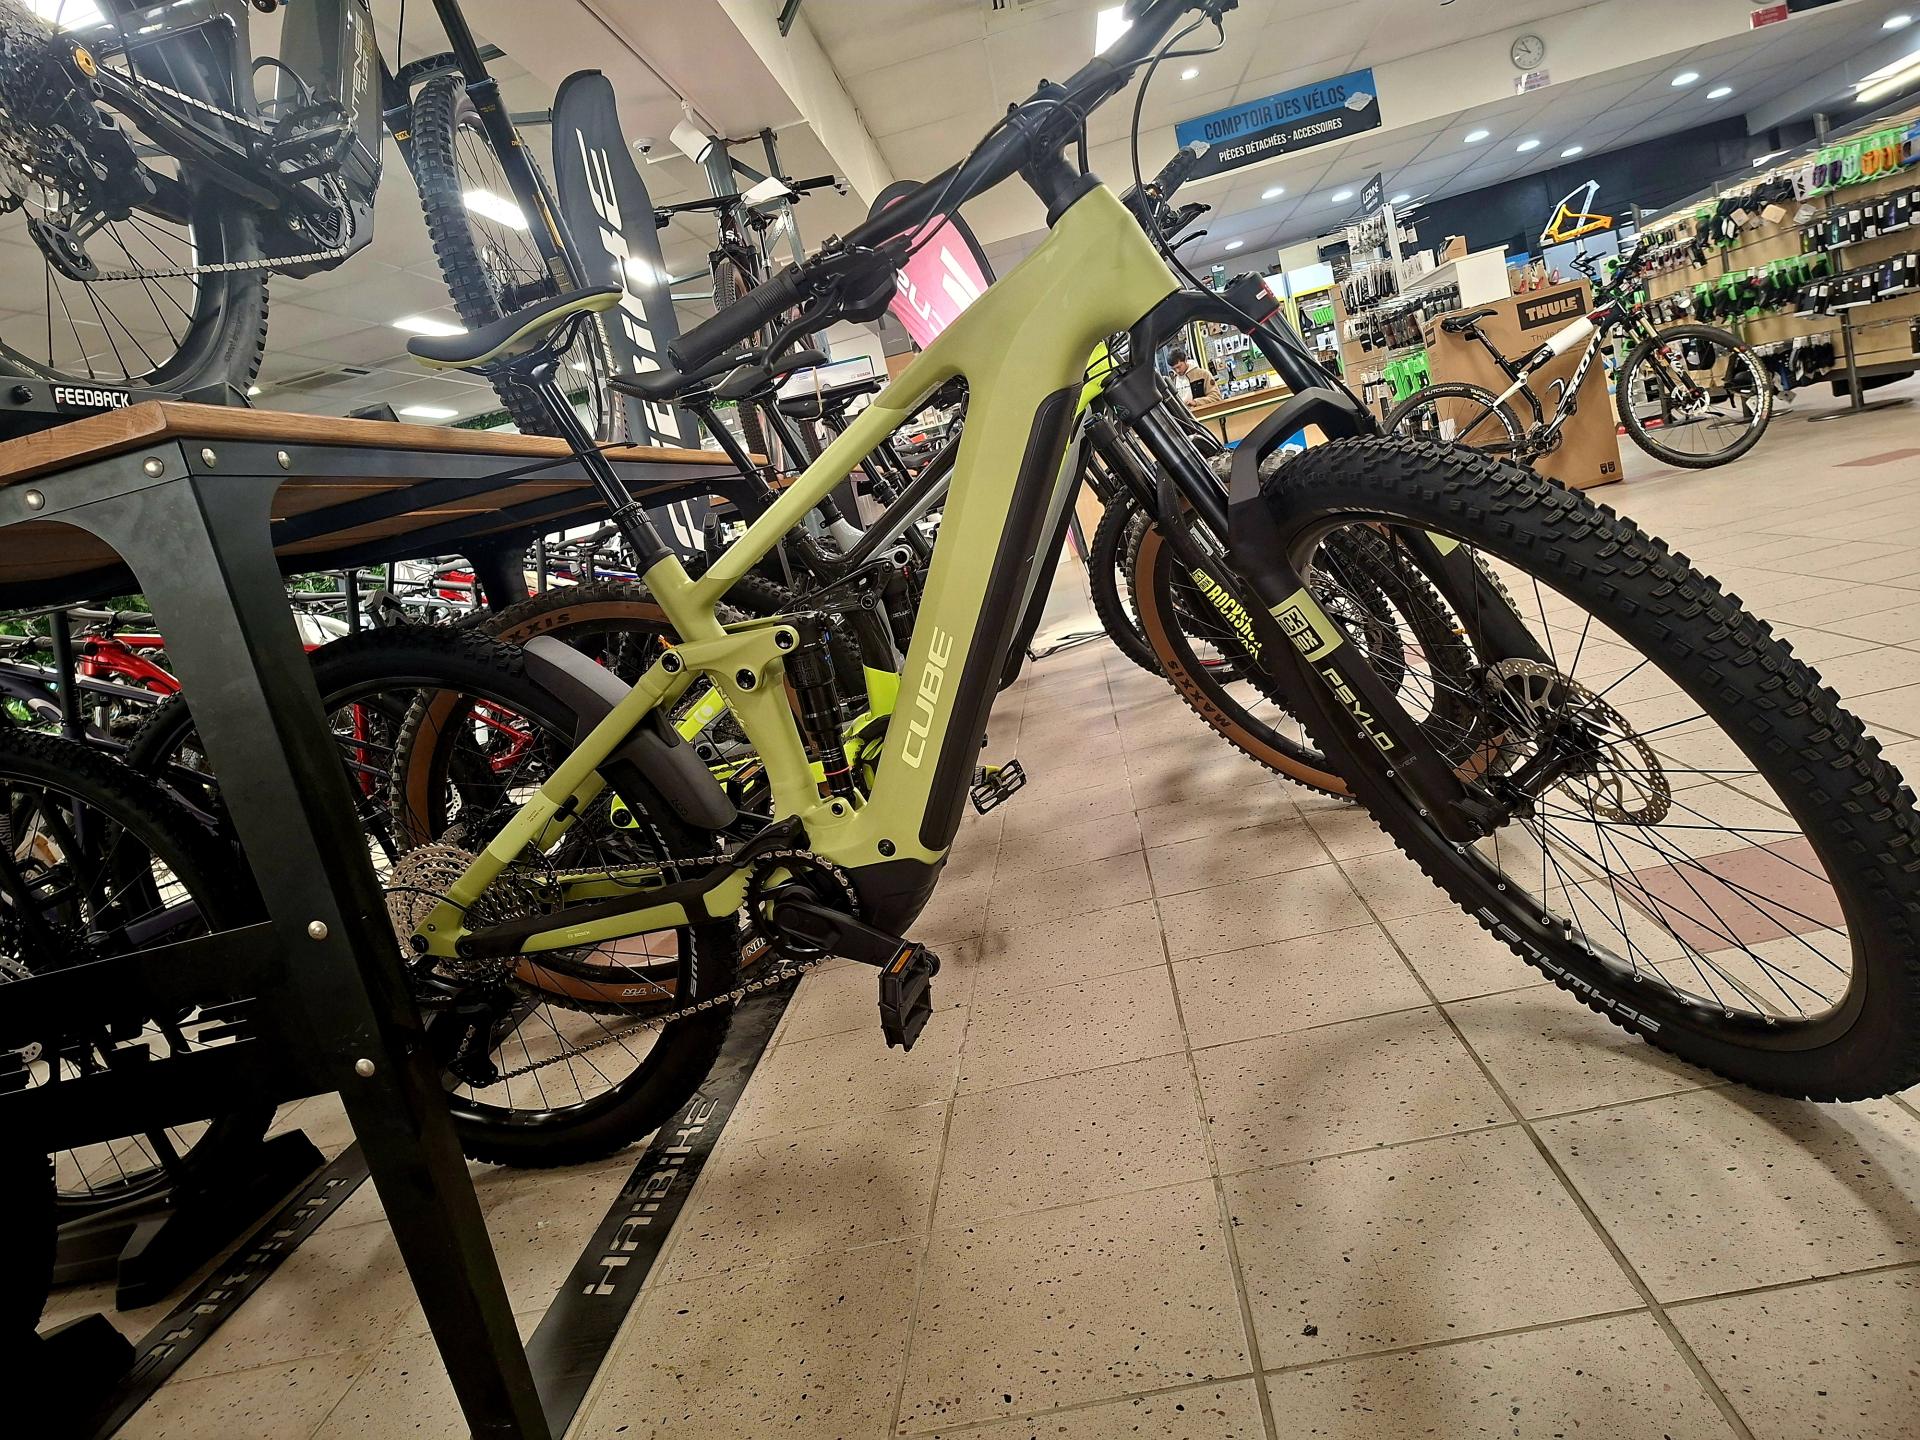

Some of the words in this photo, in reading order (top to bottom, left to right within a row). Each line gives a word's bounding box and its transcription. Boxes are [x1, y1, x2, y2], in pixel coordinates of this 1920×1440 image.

[351, 11, 363, 122] NTENSE
[1204, 107, 1273, 141] COMPTOIR
[1276, 98, 1301, 120] DES
[1304, 85, 1347, 112] VÉLOS
[1218, 145, 1245, 163] PIÈCES
[1245, 133, 1287, 155] DÉTACHÉES
[1292, 117, 1343, 141] ACCESSOIRES
[1525, 297, 1578, 322] THULE
[1571, 332, 1603, 397] SCOTT
[55, 387, 130, 408] FEEDBACK
[507, 613, 571, 642] XXIS
[1278, 609, 1305, 634] OCK
[901, 626, 953, 769] CUBE
[1168, 660, 1231, 727] MAXXIS
[1322, 667, 1395, 751] PSYLO
[1477, 906, 1661, 1033] SCHWALBE
